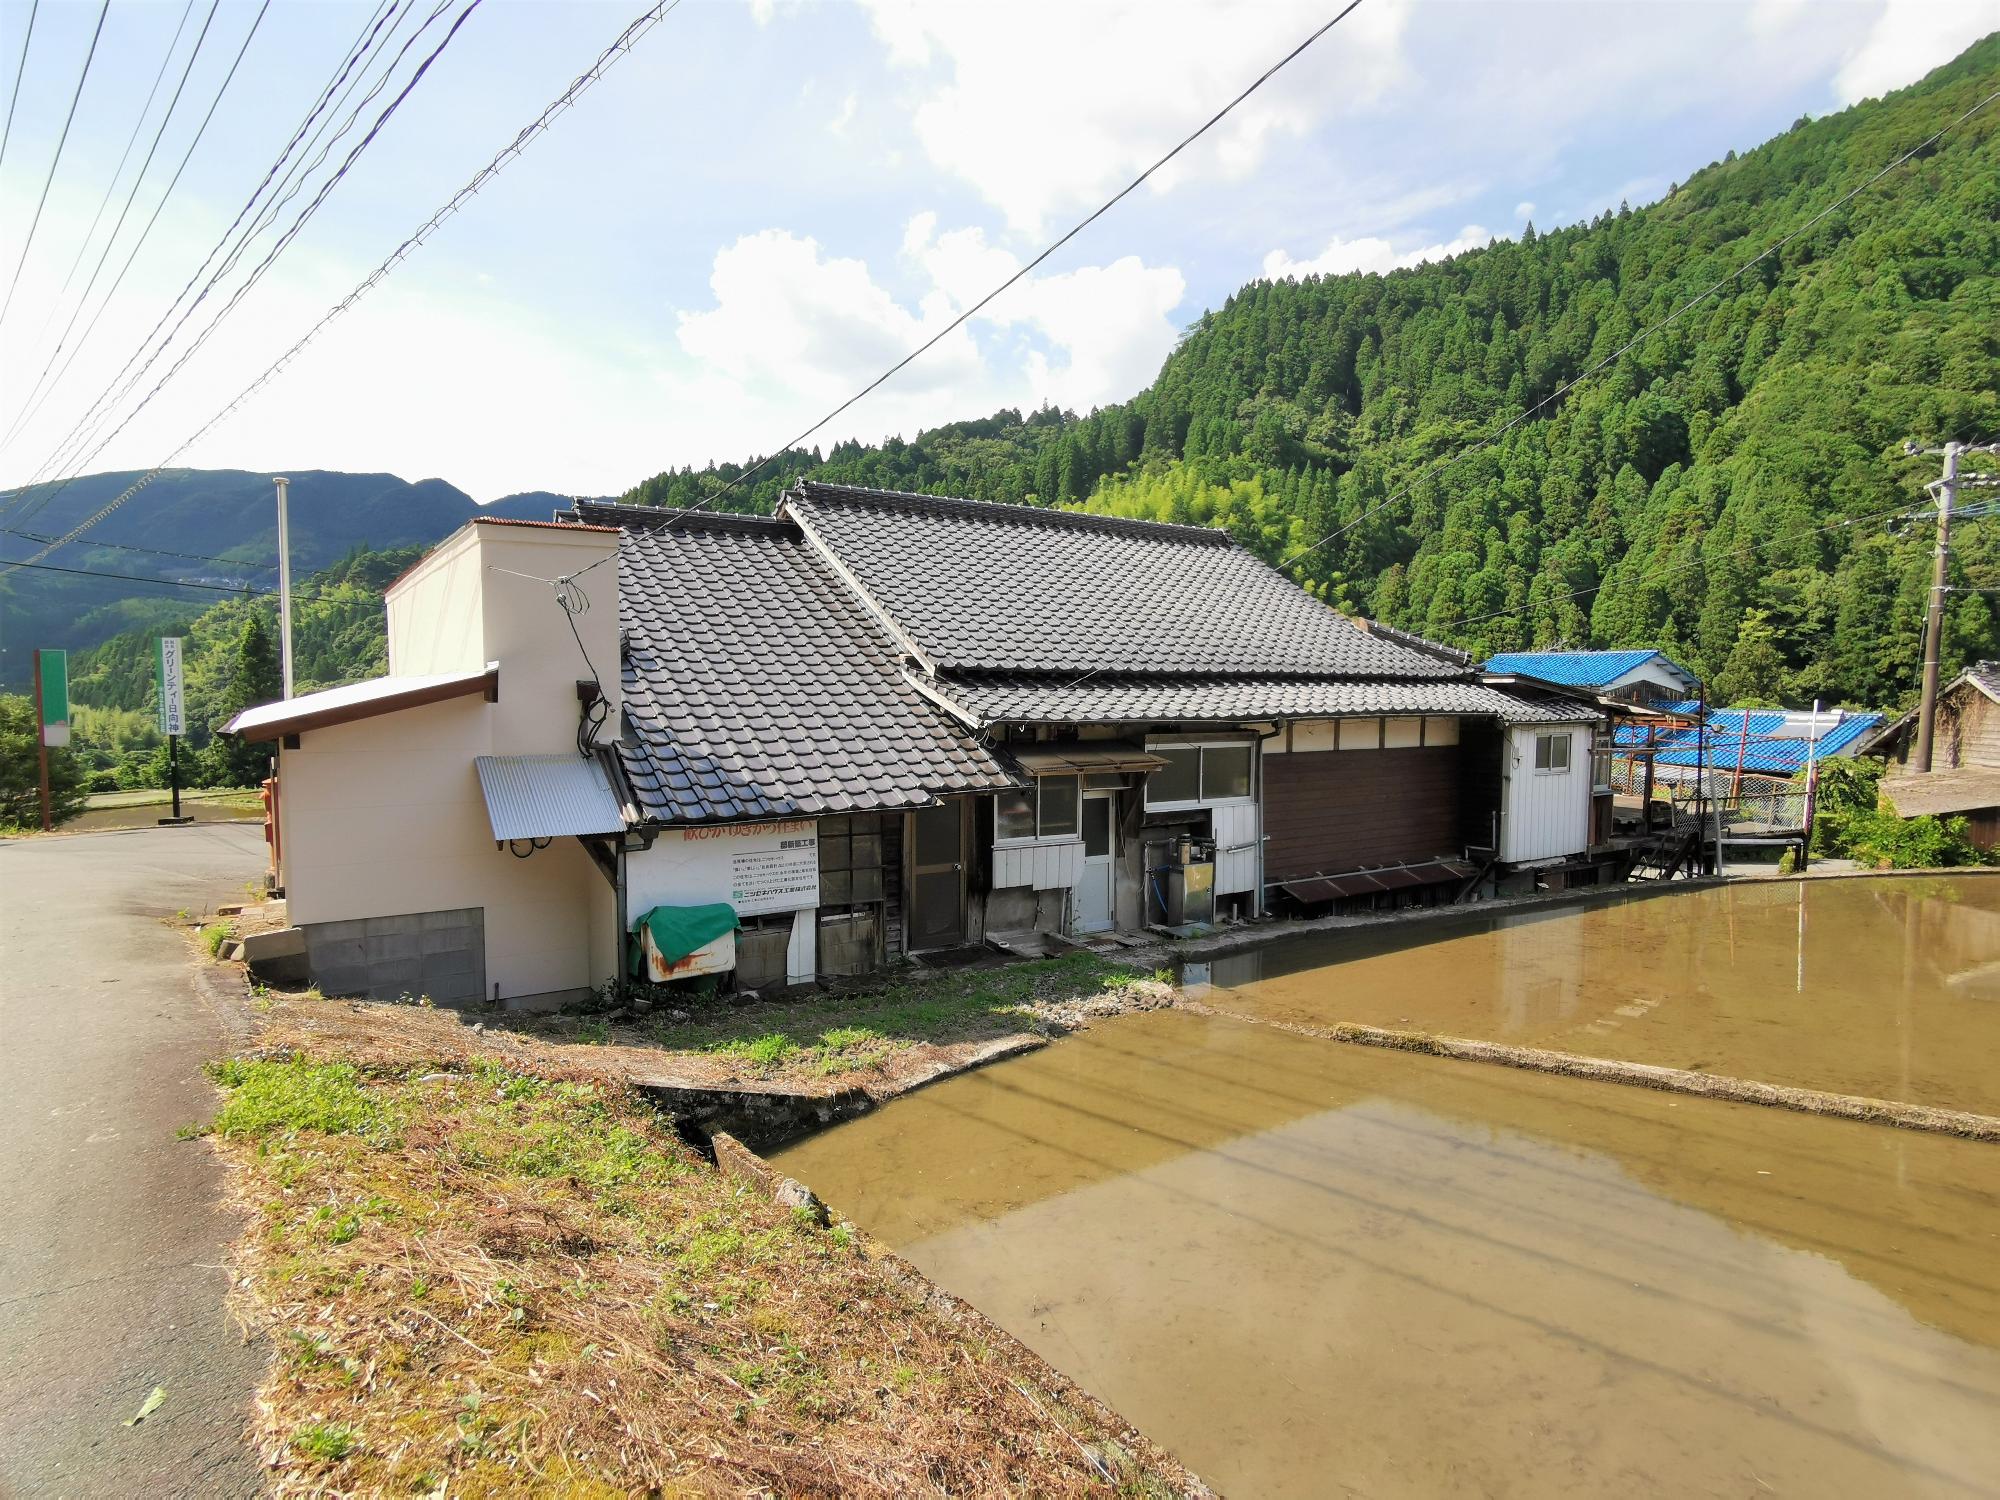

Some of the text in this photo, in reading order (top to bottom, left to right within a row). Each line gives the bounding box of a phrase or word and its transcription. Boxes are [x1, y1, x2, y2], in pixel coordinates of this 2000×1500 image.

[165, 649, 179, 732] グリーンティー日向神
